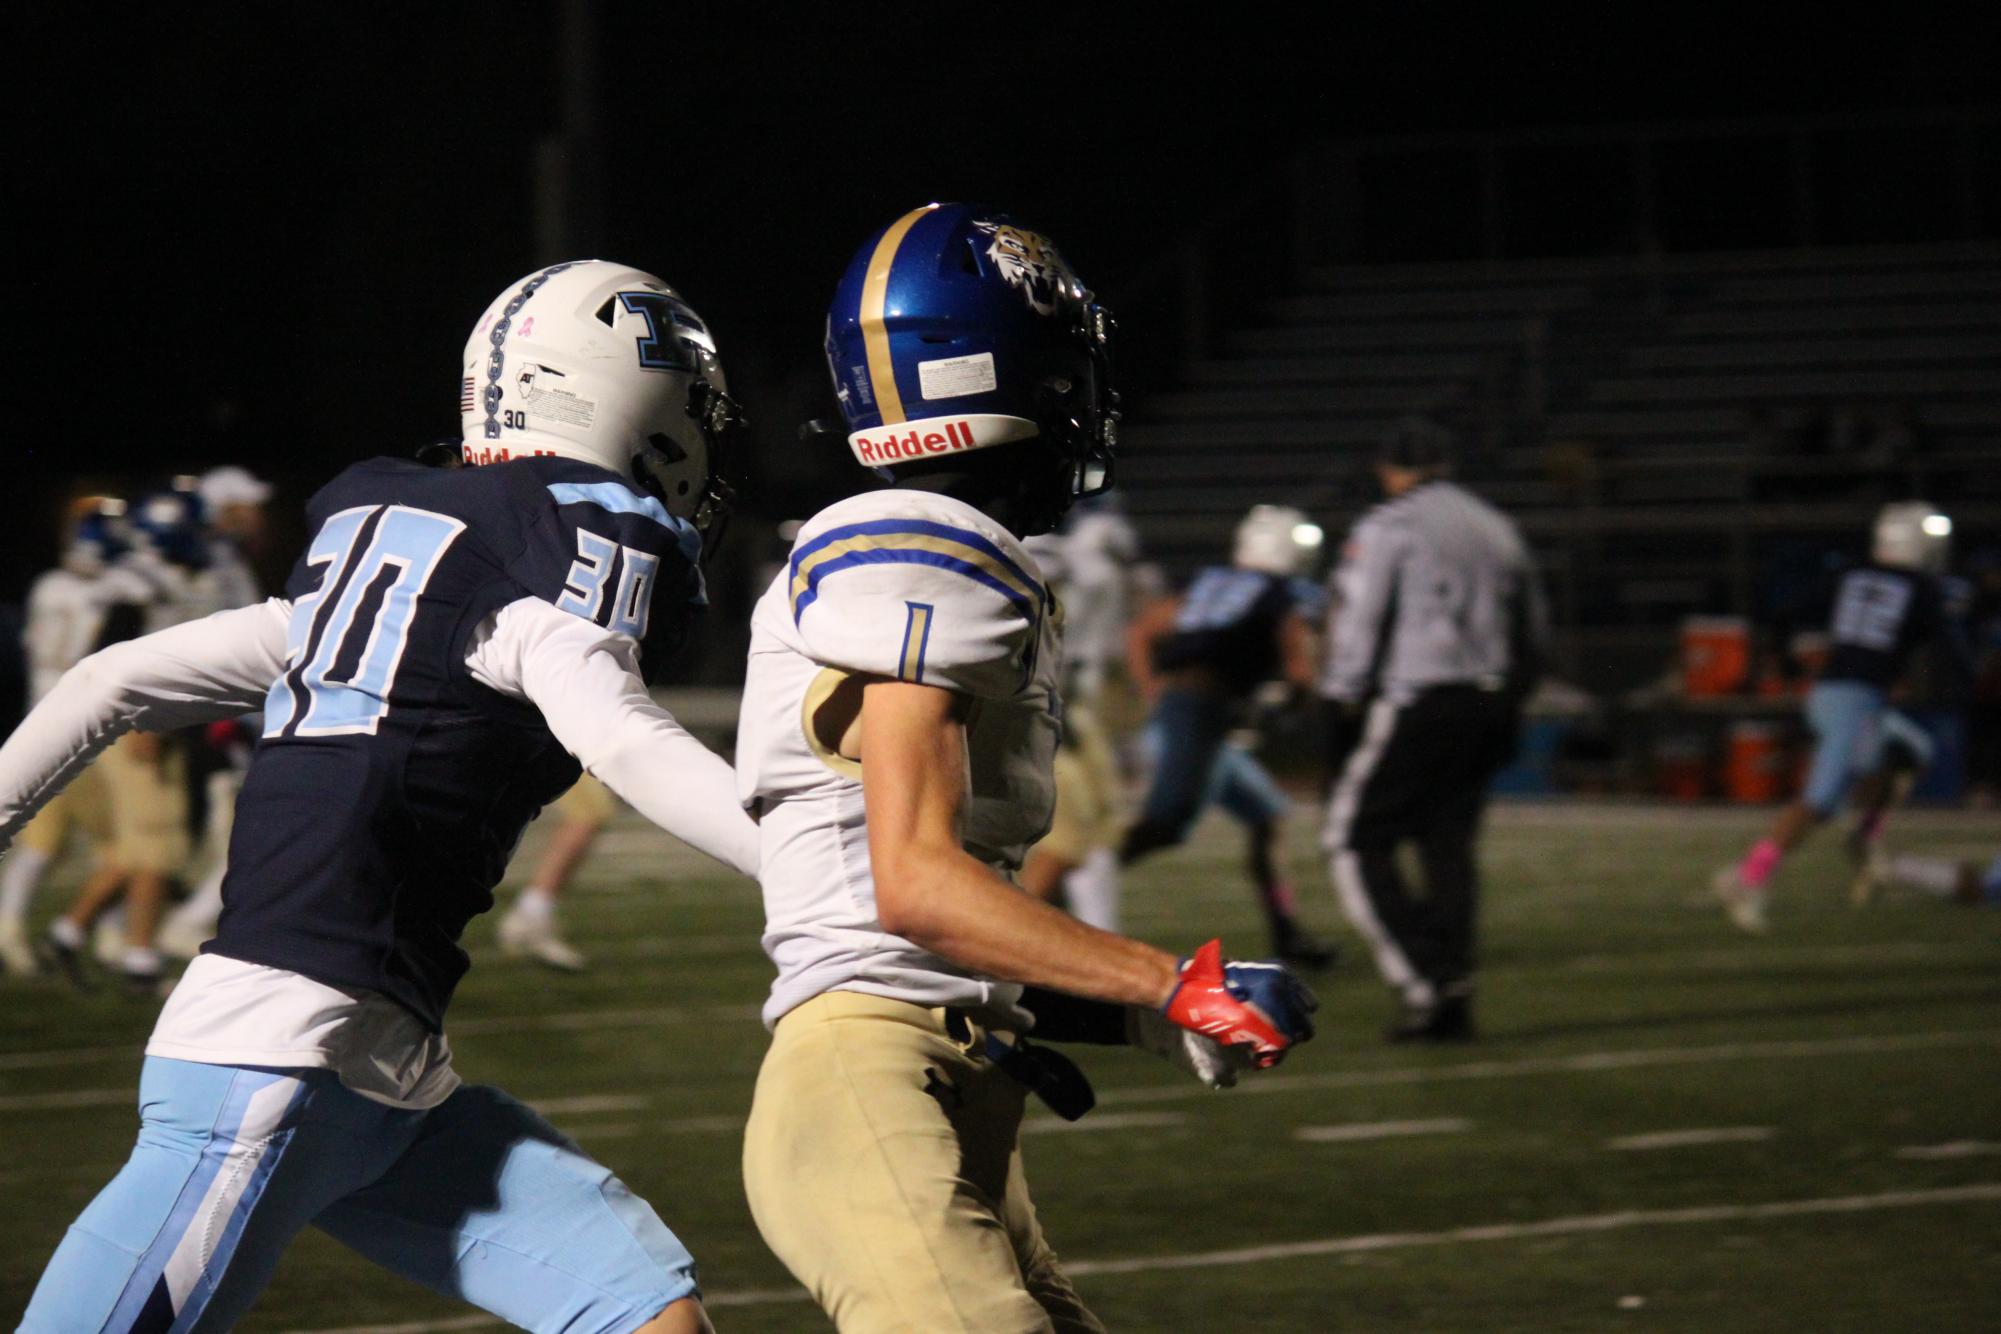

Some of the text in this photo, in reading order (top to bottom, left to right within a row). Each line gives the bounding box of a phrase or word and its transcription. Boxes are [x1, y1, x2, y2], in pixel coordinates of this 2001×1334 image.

[504, 410, 526, 430] 30
[856, 421, 976, 463] Riddell
[464, 445, 556, 466] Ridd
[555, 526, 661, 641] 30
[262, 504, 468, 739] 30
[898, 600, 934, 684] 1
